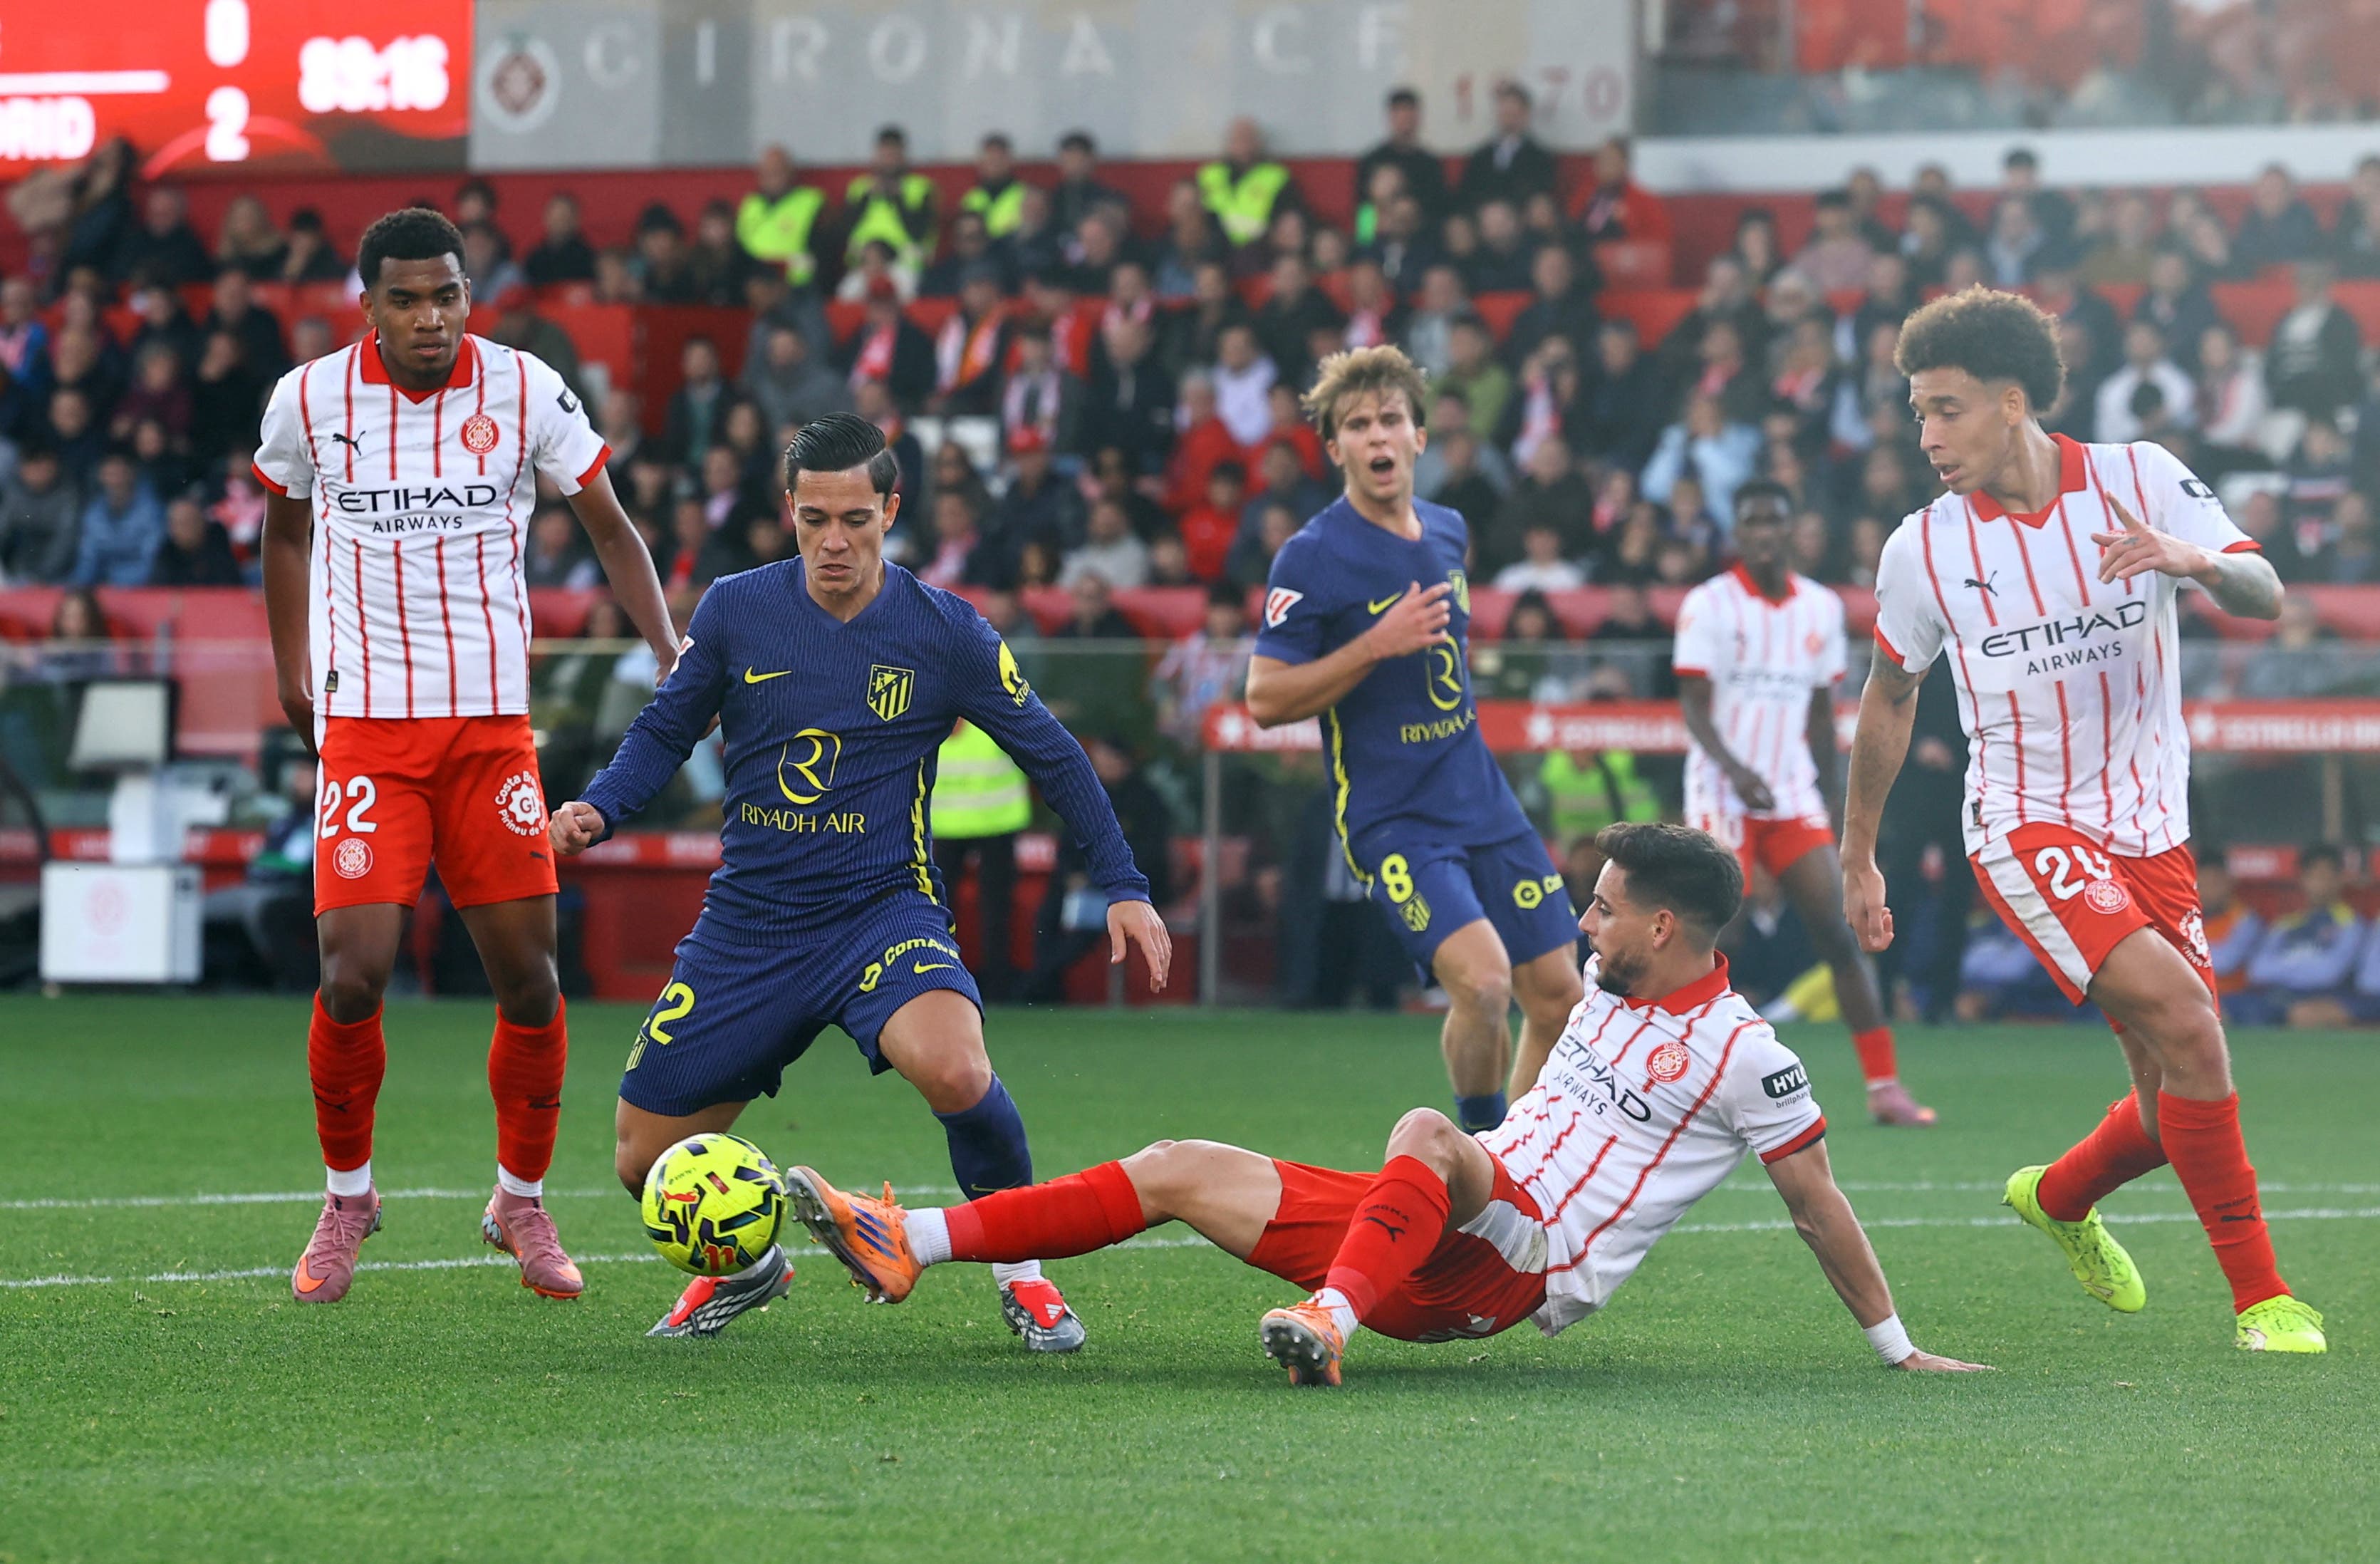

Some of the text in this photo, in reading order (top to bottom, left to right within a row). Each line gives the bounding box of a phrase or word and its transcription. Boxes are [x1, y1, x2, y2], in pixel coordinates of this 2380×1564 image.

[583, 13, 1113, 90] GIRONA
[1453, 66, 1624, 125] 170
[206, 86, 249, 162] 2
[338, 485, 497, 512] ETIHAD
[372, 515, 463, 533] AIRWAYS
[1980, 601, 2146, 658] ETIHAD
[2027, 641, 2122, 675] AIRWAYS
[1400, 714, 1466, 745] RIYADH
[320, 775, 378, 840] 22
[494, 774, 522, 806] Costa
[741, 802, 866, 834] RIYADH AIR
[338, 839, 365, 851] GIRONA
[1381, 852, 1415, 904] 8
[1663, 1043, 1688, 1062] GIRONA
[1553, 1069, 1609, 1116] AIRWAYS
[1556, 1034, 1652, 1122] ETIHAD
